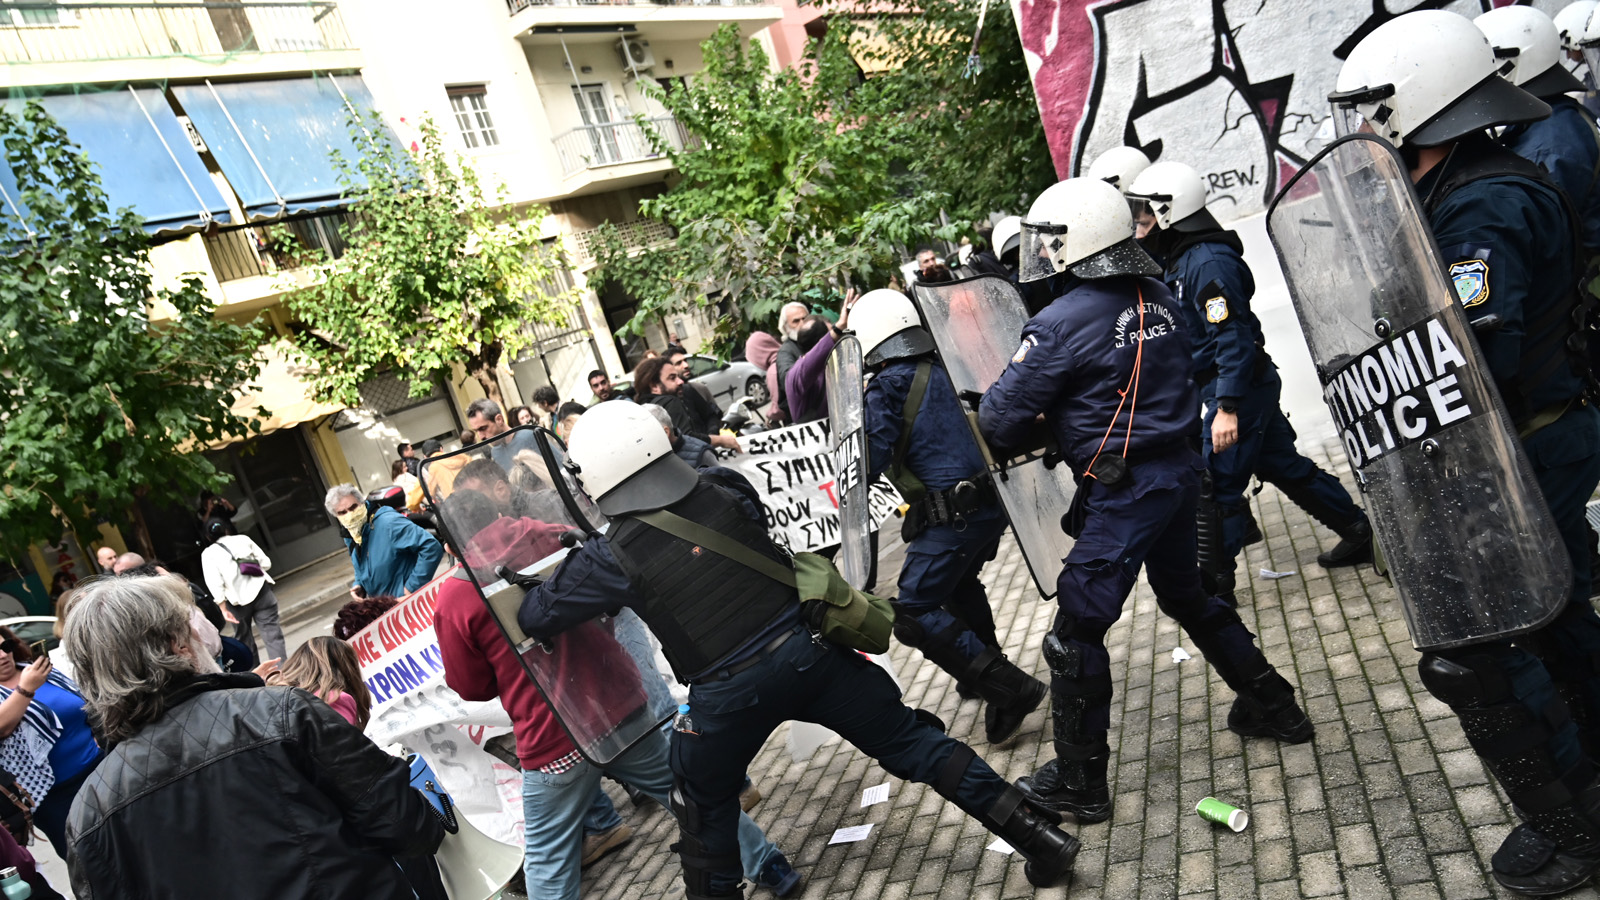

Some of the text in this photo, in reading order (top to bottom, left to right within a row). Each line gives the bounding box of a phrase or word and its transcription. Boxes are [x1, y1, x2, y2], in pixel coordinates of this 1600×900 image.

[1129, 324, 1167, 344] POLICE
[1325, 318, 1466, 429] ΤΥΝΟΜΙΑ
[1336, 373, 1471, 468] OLICE
[352, 582, 443, 668] ΜΕ ΔΙΚΑΙΩΜ
[364, 653, 431, 709] ΧΡΟΝΑ
